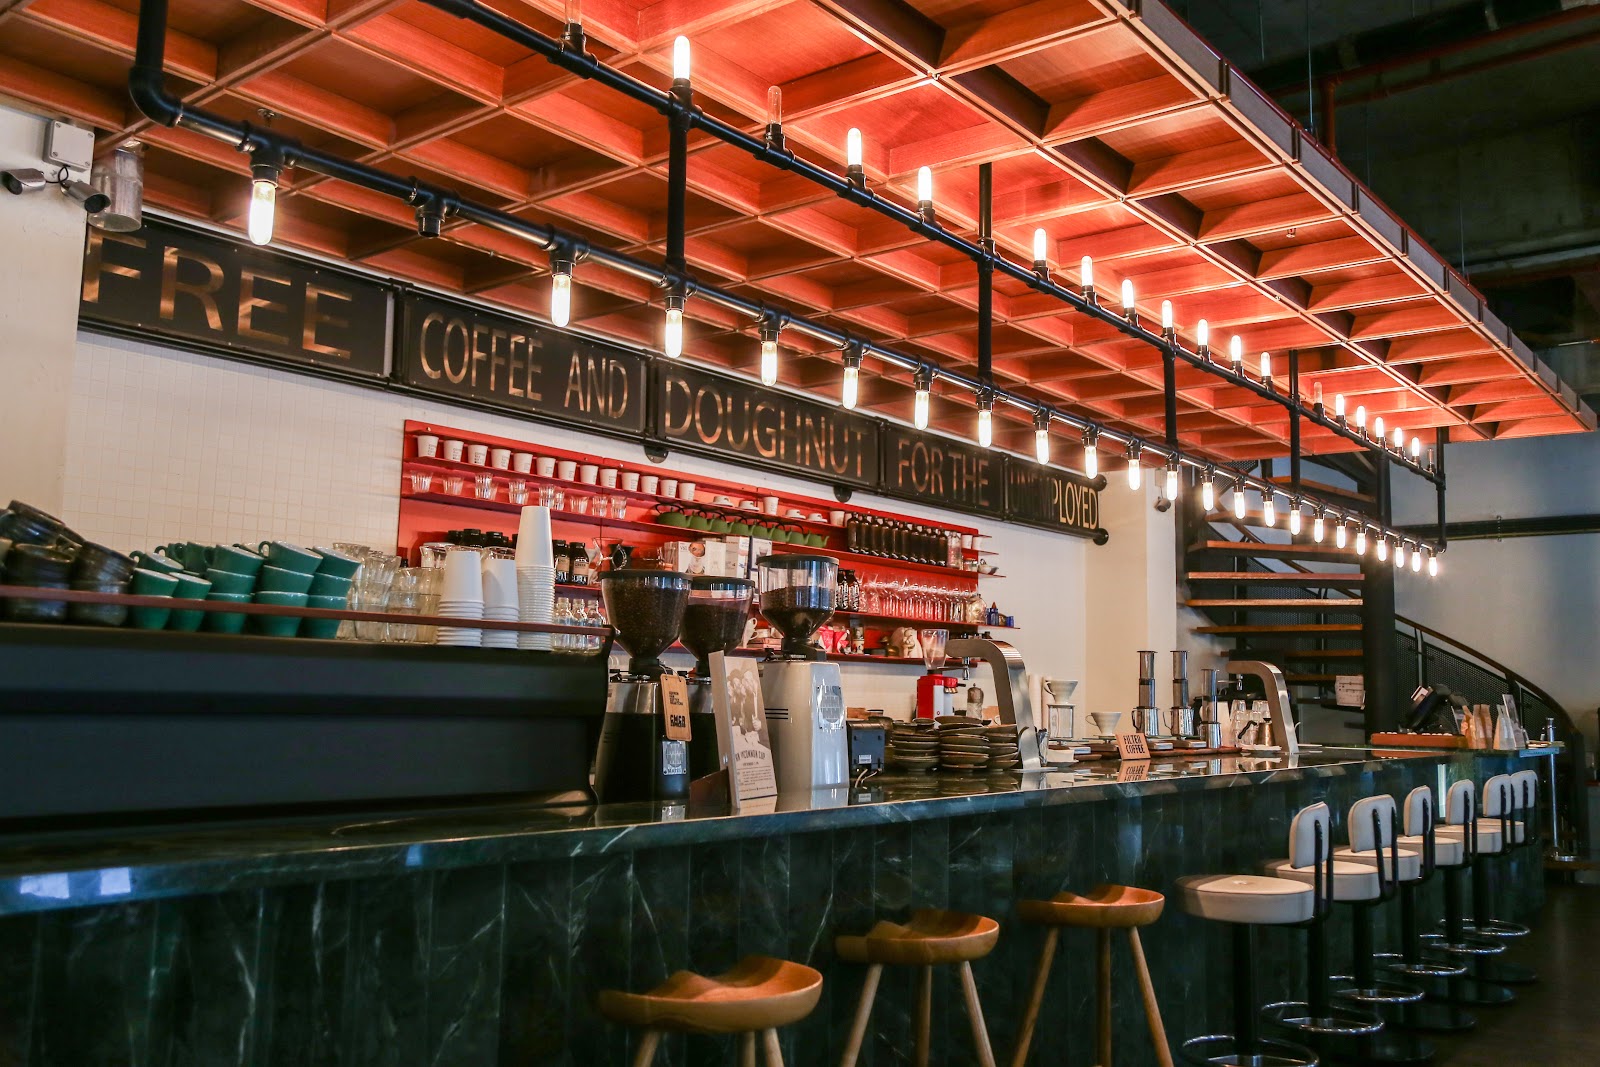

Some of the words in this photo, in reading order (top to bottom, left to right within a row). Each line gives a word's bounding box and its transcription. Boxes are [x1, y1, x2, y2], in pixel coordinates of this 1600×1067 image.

[83, 226, 352, 359] FREE
[420, 312, 543, 401] COFFEE
[564, 351, 628, 418] AND
[665, 375, 869, 478] DOUGHNUT
[898, 439, 944, 496] FOR
[949, 453, 990, 507] THE
[1123, 735, 1142, 745] FILTER
[1126, 744, 1145, 754] COFFEE
